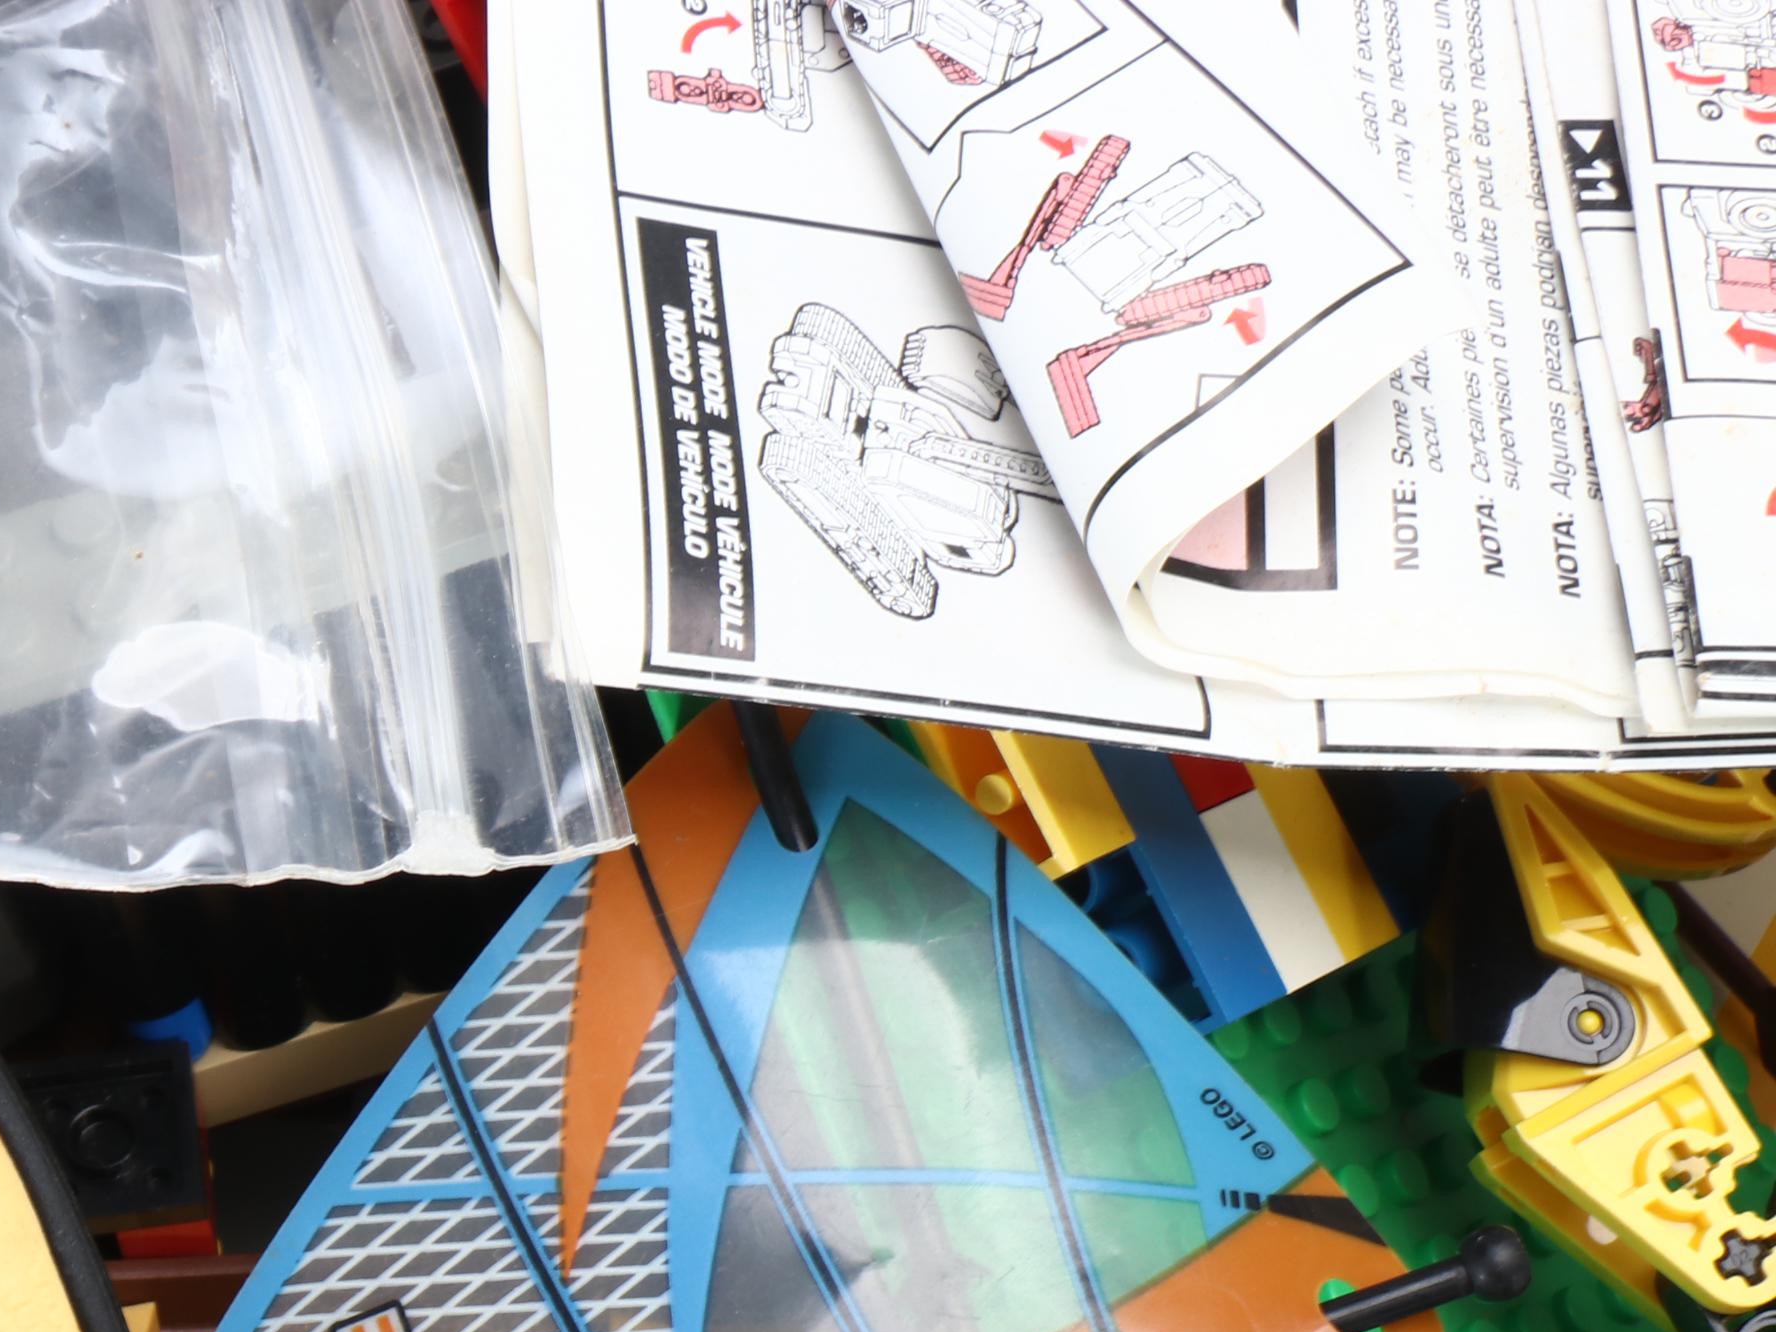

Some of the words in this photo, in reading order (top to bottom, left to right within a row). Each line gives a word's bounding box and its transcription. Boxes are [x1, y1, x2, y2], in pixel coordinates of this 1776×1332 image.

[1353, 66, 1374, 83] if
[1437, 38, 1456, 93] sous
[1387, 99, 1408, 128] be
[1469, 99, 1490, 147] être
[1395, 134, 1415, 184] may
[1473, 155, 1502, 211] peut
[1574, 158, 1619, 201] 11
[685, 237, 719, 339] VEHICLE
[1477, 217, 1501, 290] adulte
[662, 304, 694, 385] MODO
[1484, 299, 1506, 348] d'un
[1539, 318, 1570, 395] piezas
[672, 386, 698, 426] DE
[697, 340, 729, 420] MODE
[1391, 399, 1414, 468] Some
[1421, 404, 1444, 474] occur.
[1462, 370, 1491, 484] Certaines
[1488, 357, 1523, 491] supervision
[1548, 400, 1577, 500] Algunas
[676, 429, 711, 560] VEHÍCULO
[707, 429, 738, 512] MODE
[1392, 479, 1419, 570] NOTE:
[1475, 495, 1506, 578] NOTA:
[1551, 511, 1581, 599] NOTA:
[716, 516, 747, 652] VÉHICULE
[1200, 1088, 1256, 1141] LEGO
